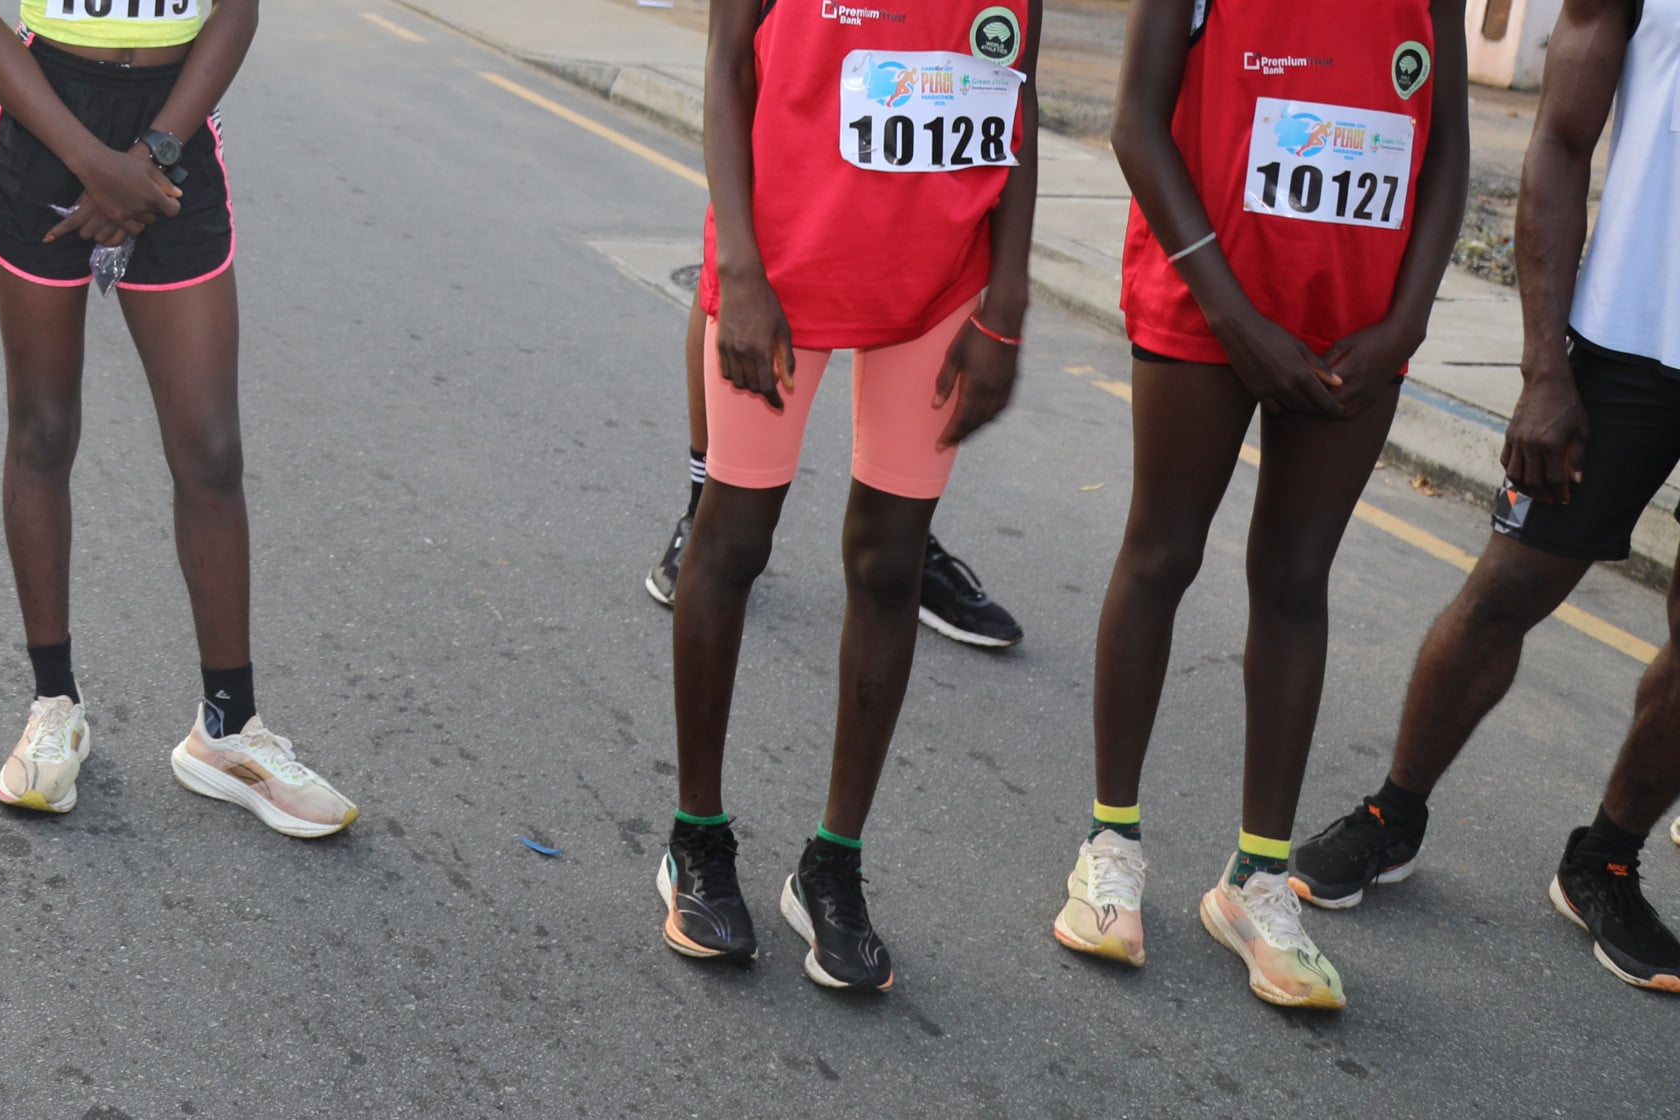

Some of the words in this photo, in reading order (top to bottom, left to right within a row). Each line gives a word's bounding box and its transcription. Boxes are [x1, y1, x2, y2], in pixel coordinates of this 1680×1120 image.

[840, 15, 862, 26] Bank
[1263, 65, 1285, 75] Bank
[921, 72, 954, 94] PEACE
[849, 115, 1007, 166] 10128
[1333, 126, 1366, 150] PEACE
[1256, 161, 1399, 222] 10127
